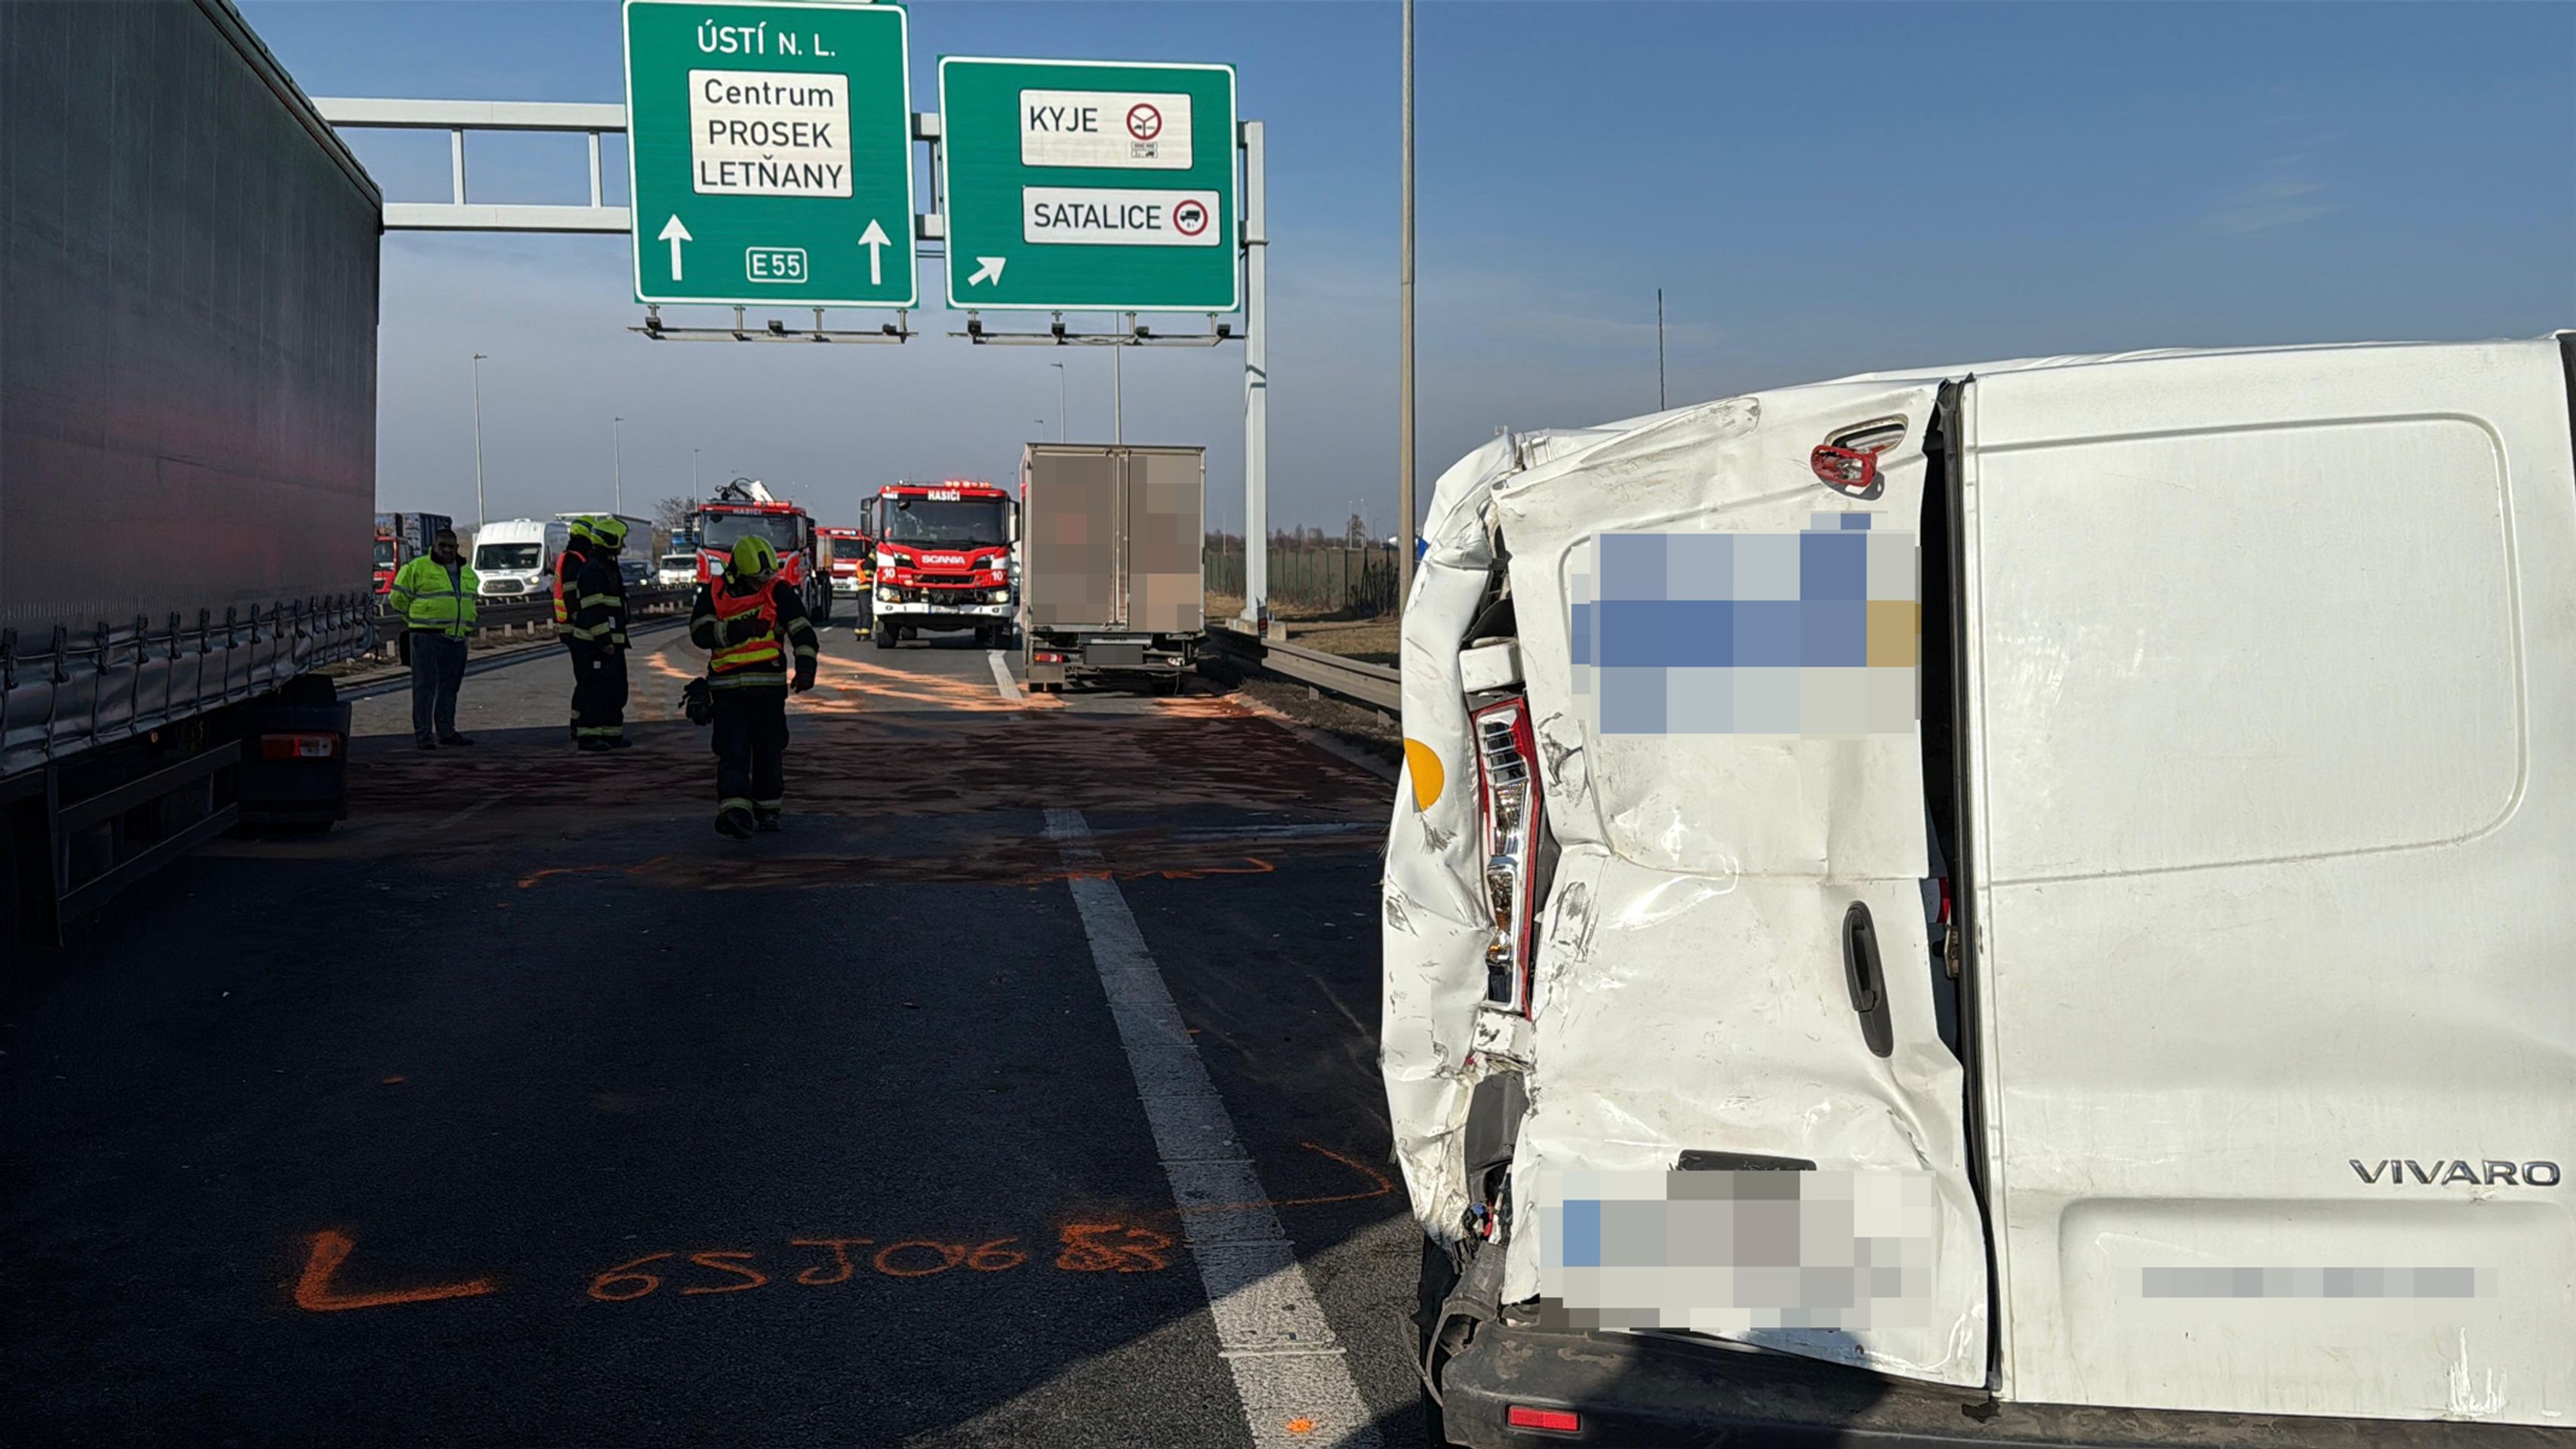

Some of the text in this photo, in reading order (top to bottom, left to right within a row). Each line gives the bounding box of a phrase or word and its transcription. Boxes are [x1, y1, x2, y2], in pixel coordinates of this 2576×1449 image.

[697, 19, 836, 57] ÚSTÍ N. L.
[704, 78, 834, 107] Centrum
[1030, 106, 1098, 133] KYJE
[708, 119, 833, 148] PROSEK
[700, 154, 843, 190] LETŇANY
[1033, 203, 1162, 229] SATALICE
[883, 568, 896, 579] 10
[921, 555, 966, 565] SCANIA
[991, 571, 1004, 582] 10
[2348, 1158, 2562, 1186] VIVARO
